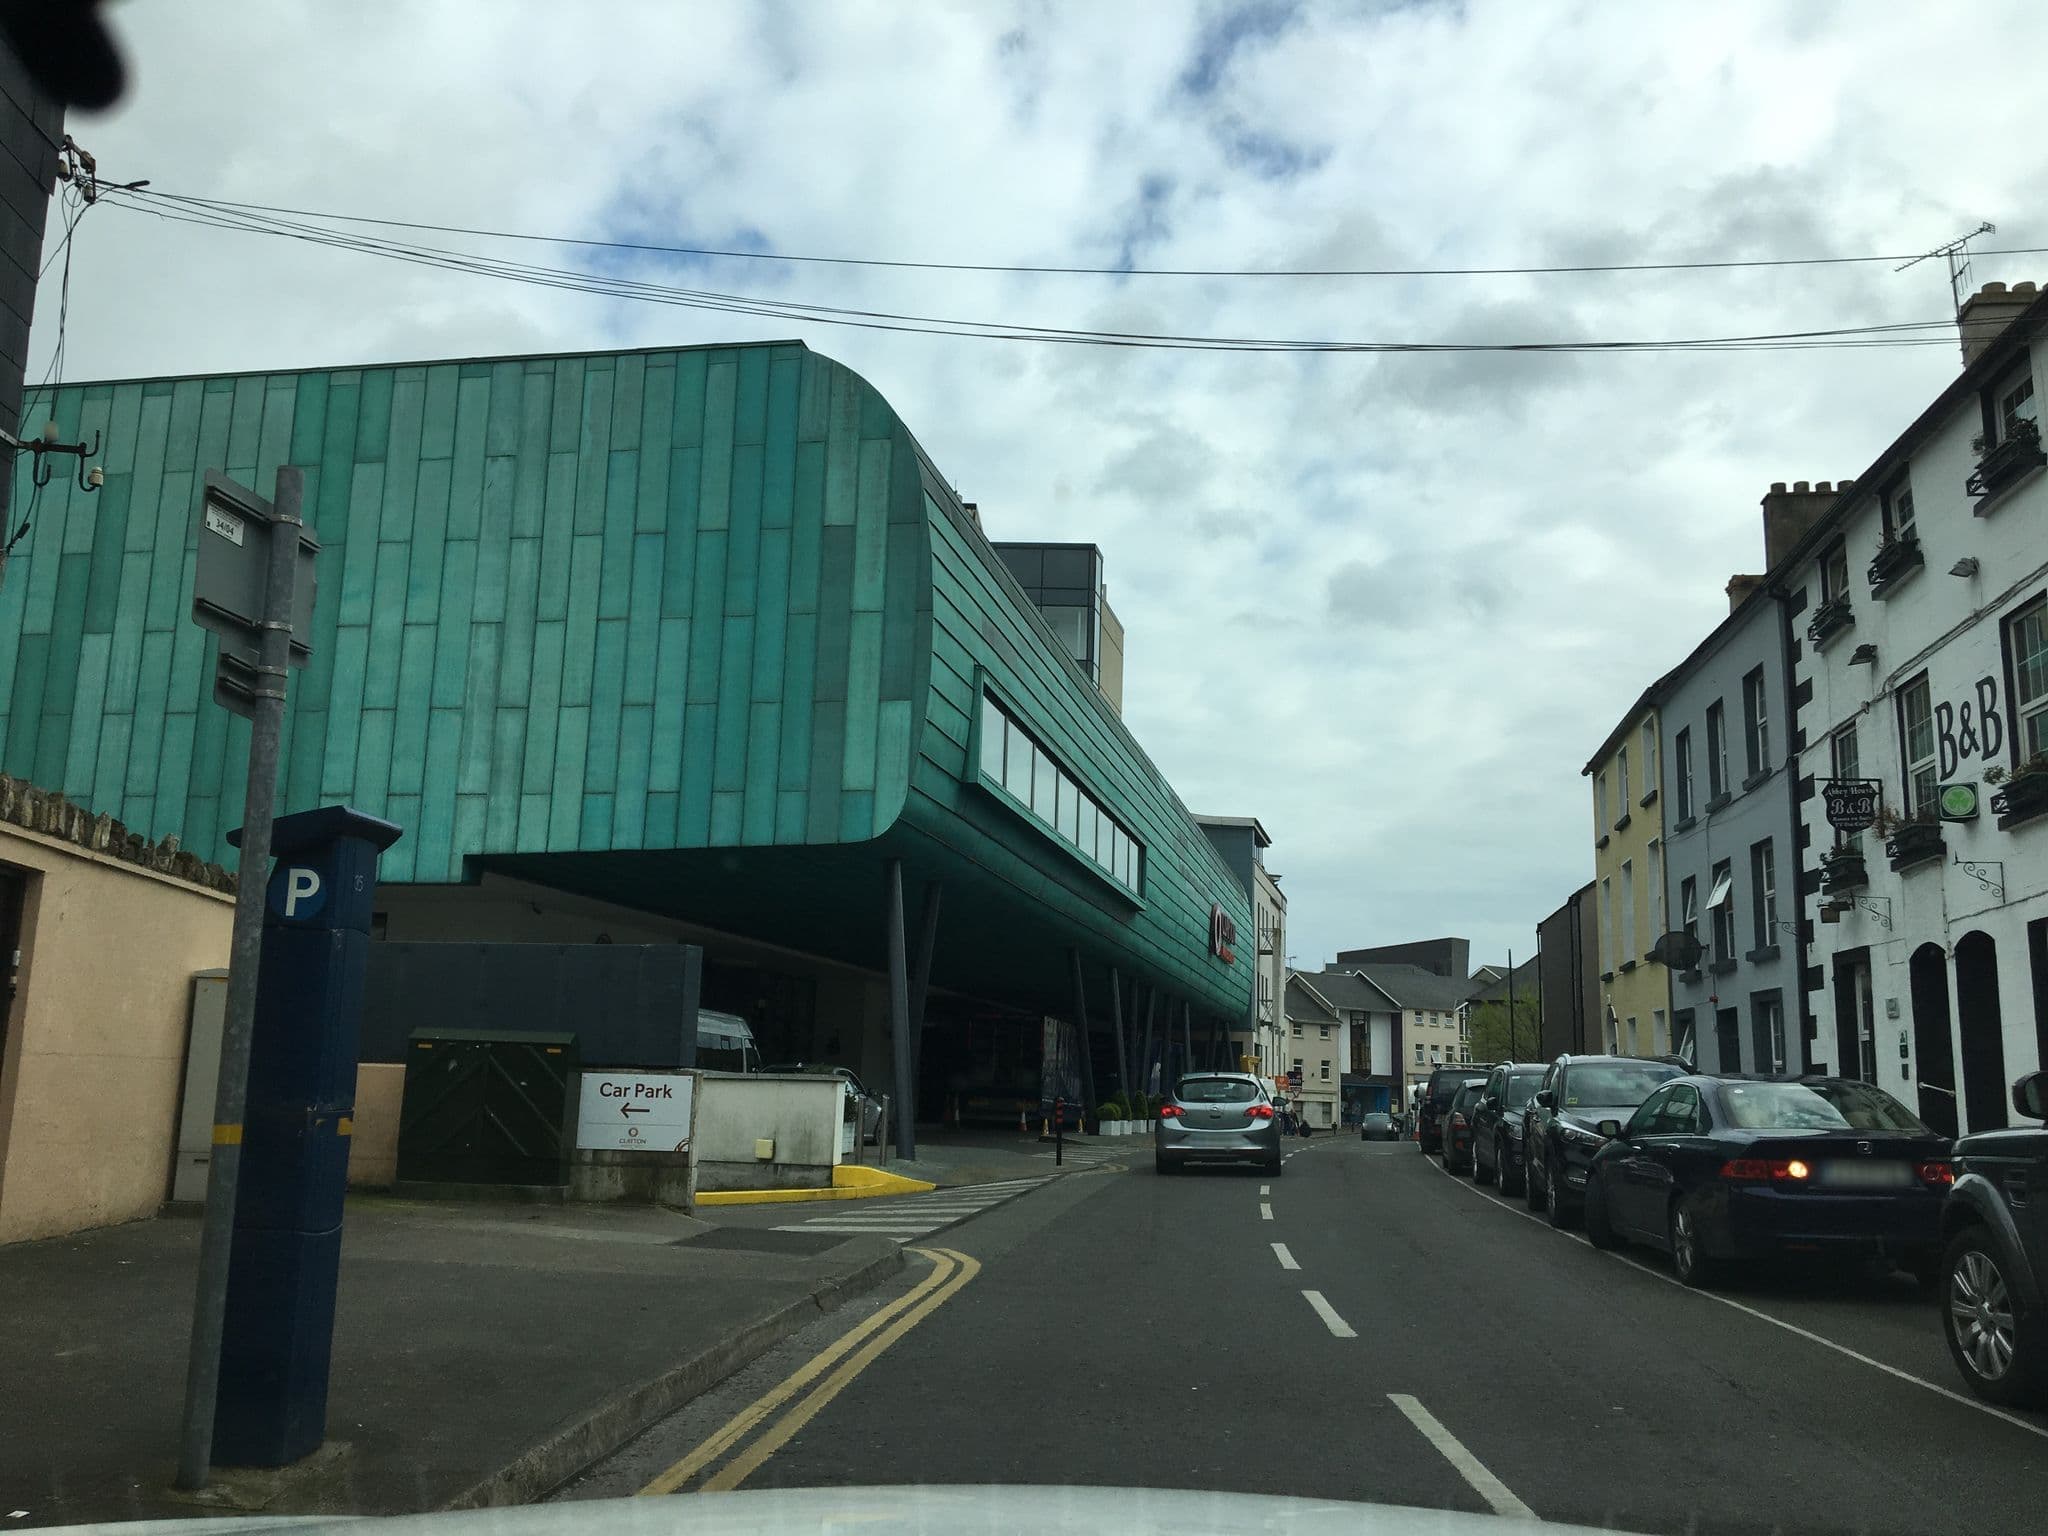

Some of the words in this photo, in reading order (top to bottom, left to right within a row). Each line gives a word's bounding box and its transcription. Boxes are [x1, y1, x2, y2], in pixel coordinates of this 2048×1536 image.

[1934, 675, 2003, 782] B&B
[1831, 799, 1844, 814] B
[1846, 803, 1855, 813] &
[1857, 797, 1871, 813] B
[286, 868, 320, 916] P
[600, 1082, 631, 1098] Car
[635, 1083, 672, 1099] Park
